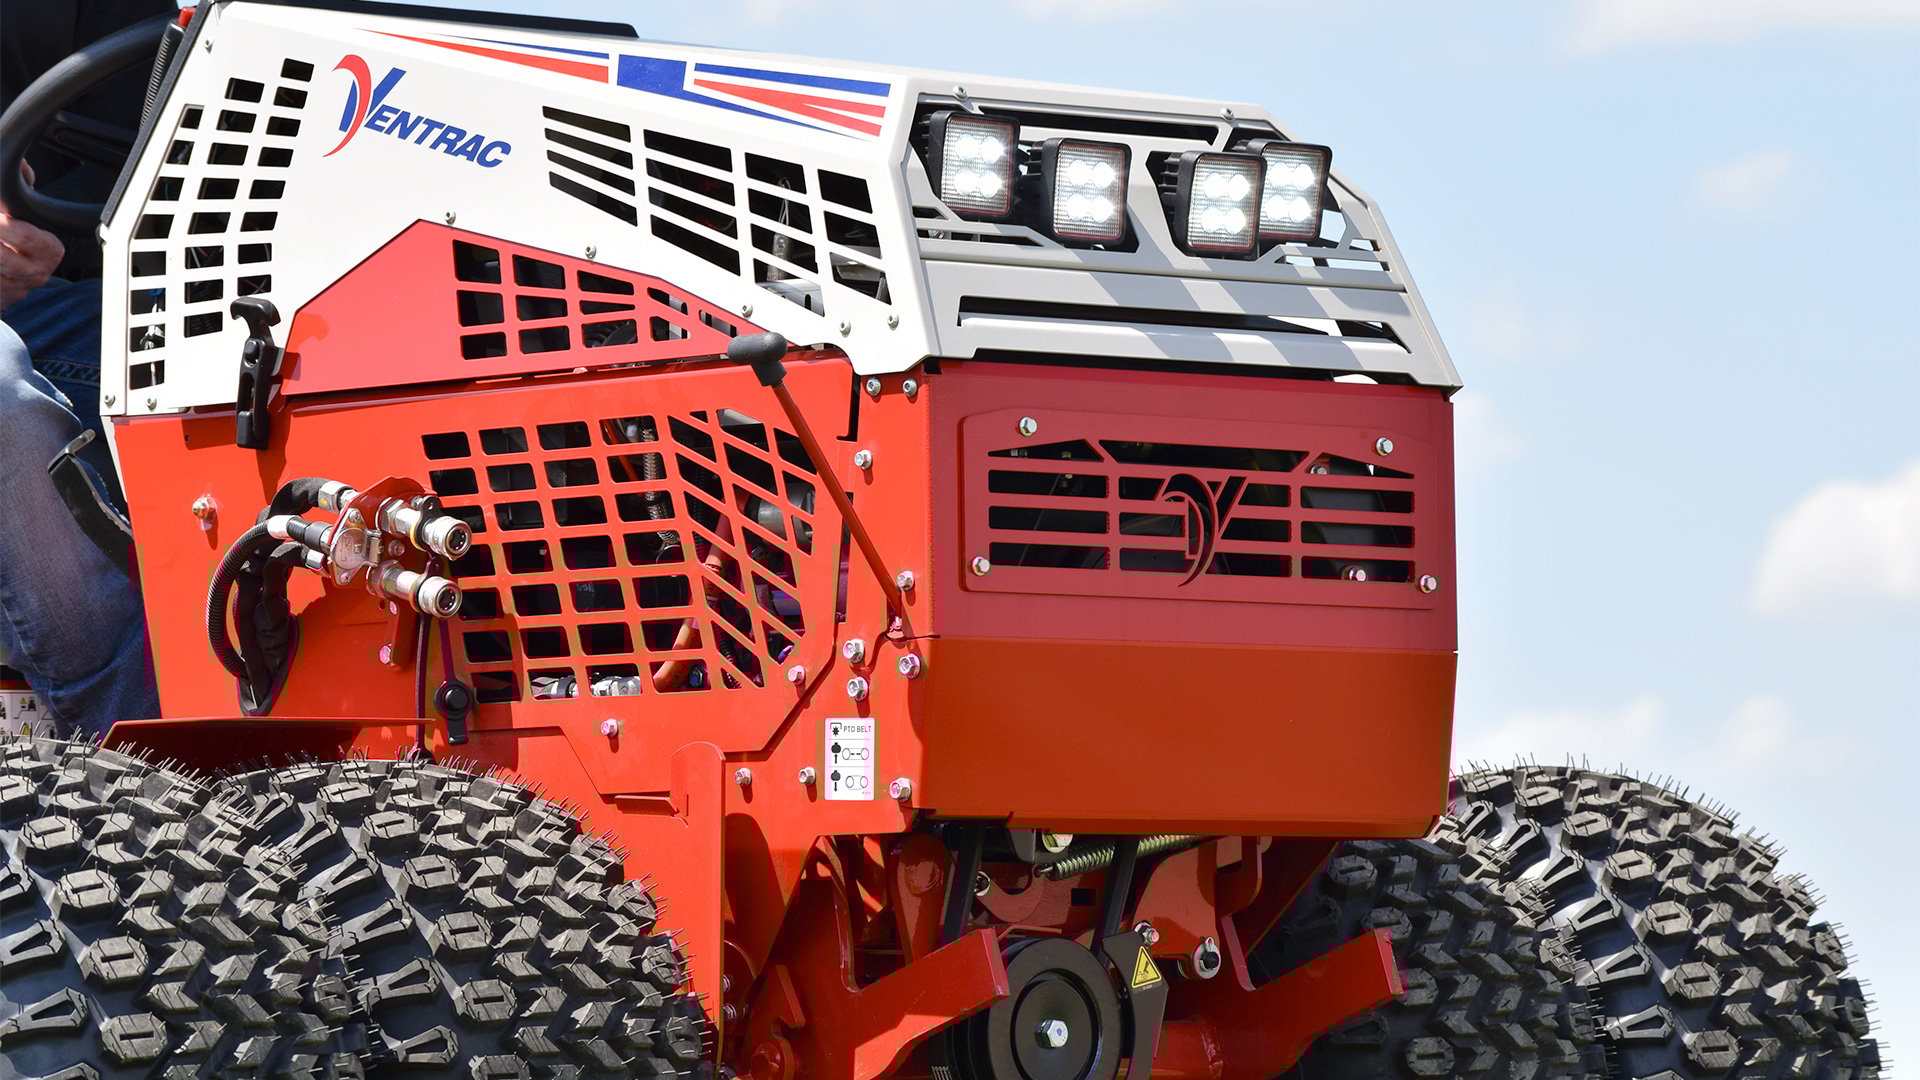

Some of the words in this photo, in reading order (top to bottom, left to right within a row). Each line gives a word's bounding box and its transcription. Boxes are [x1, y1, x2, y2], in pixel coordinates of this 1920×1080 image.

[322, 54, 512, 168] VENTRAC
[843, 725, 856, 733] PTO
[856, 725, 872, 733] BELT
